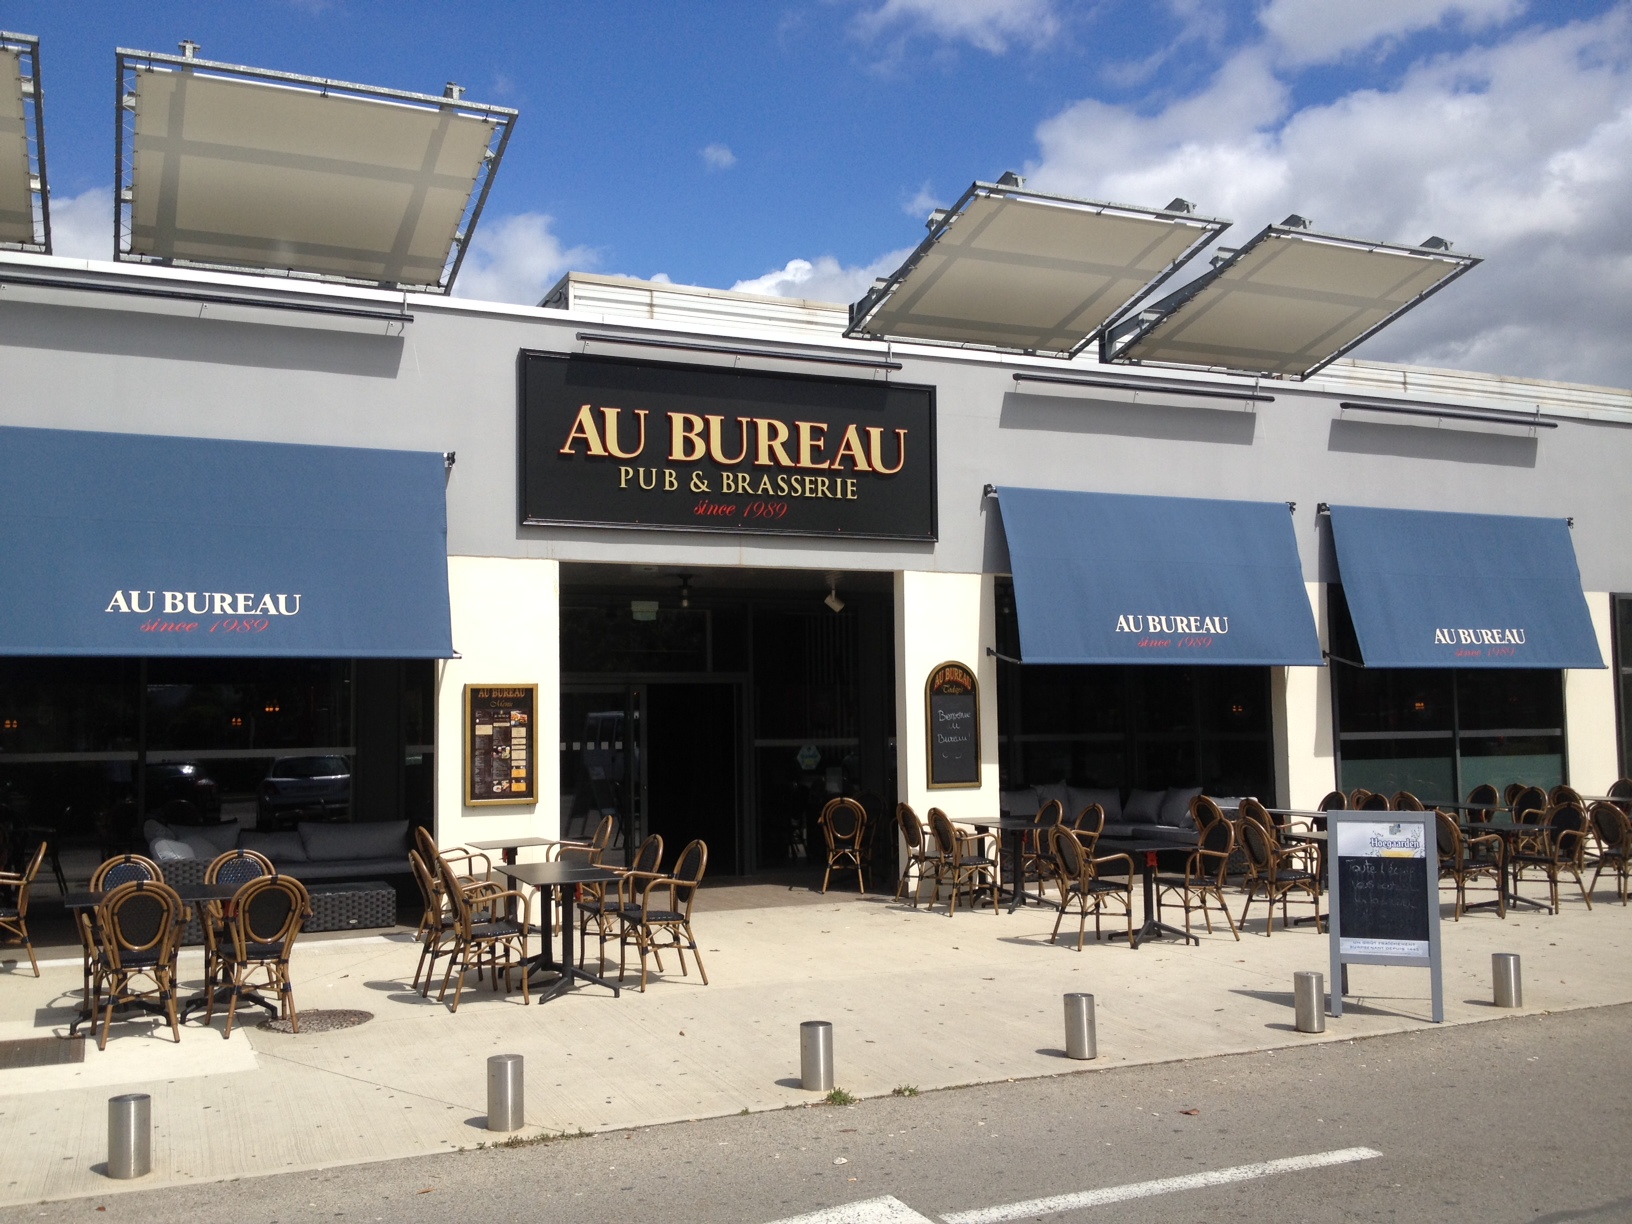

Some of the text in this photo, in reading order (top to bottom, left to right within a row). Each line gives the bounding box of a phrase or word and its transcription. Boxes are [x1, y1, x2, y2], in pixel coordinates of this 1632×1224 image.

[559, 404, 908, 474] AU BUREAU
[618, 466, 858, 499] PUB & BRASSERIE
[693, 500, 788, 520] since 1989
[105, 590, 301, 616] AU BUREAU
[139, 618, 270, 634] since 1989
[1115, 614, 1229, 634] AU BUREAU
[1138, 636, 1213, 648] since 1989
[1434, 628, 1526, 645] AU BUREAU
[945, 667, 972, 690] BUREAU
[478, 688, 526, 698] AU BUREAU
[1369, 837, 1420, 850] Hoegaarden
